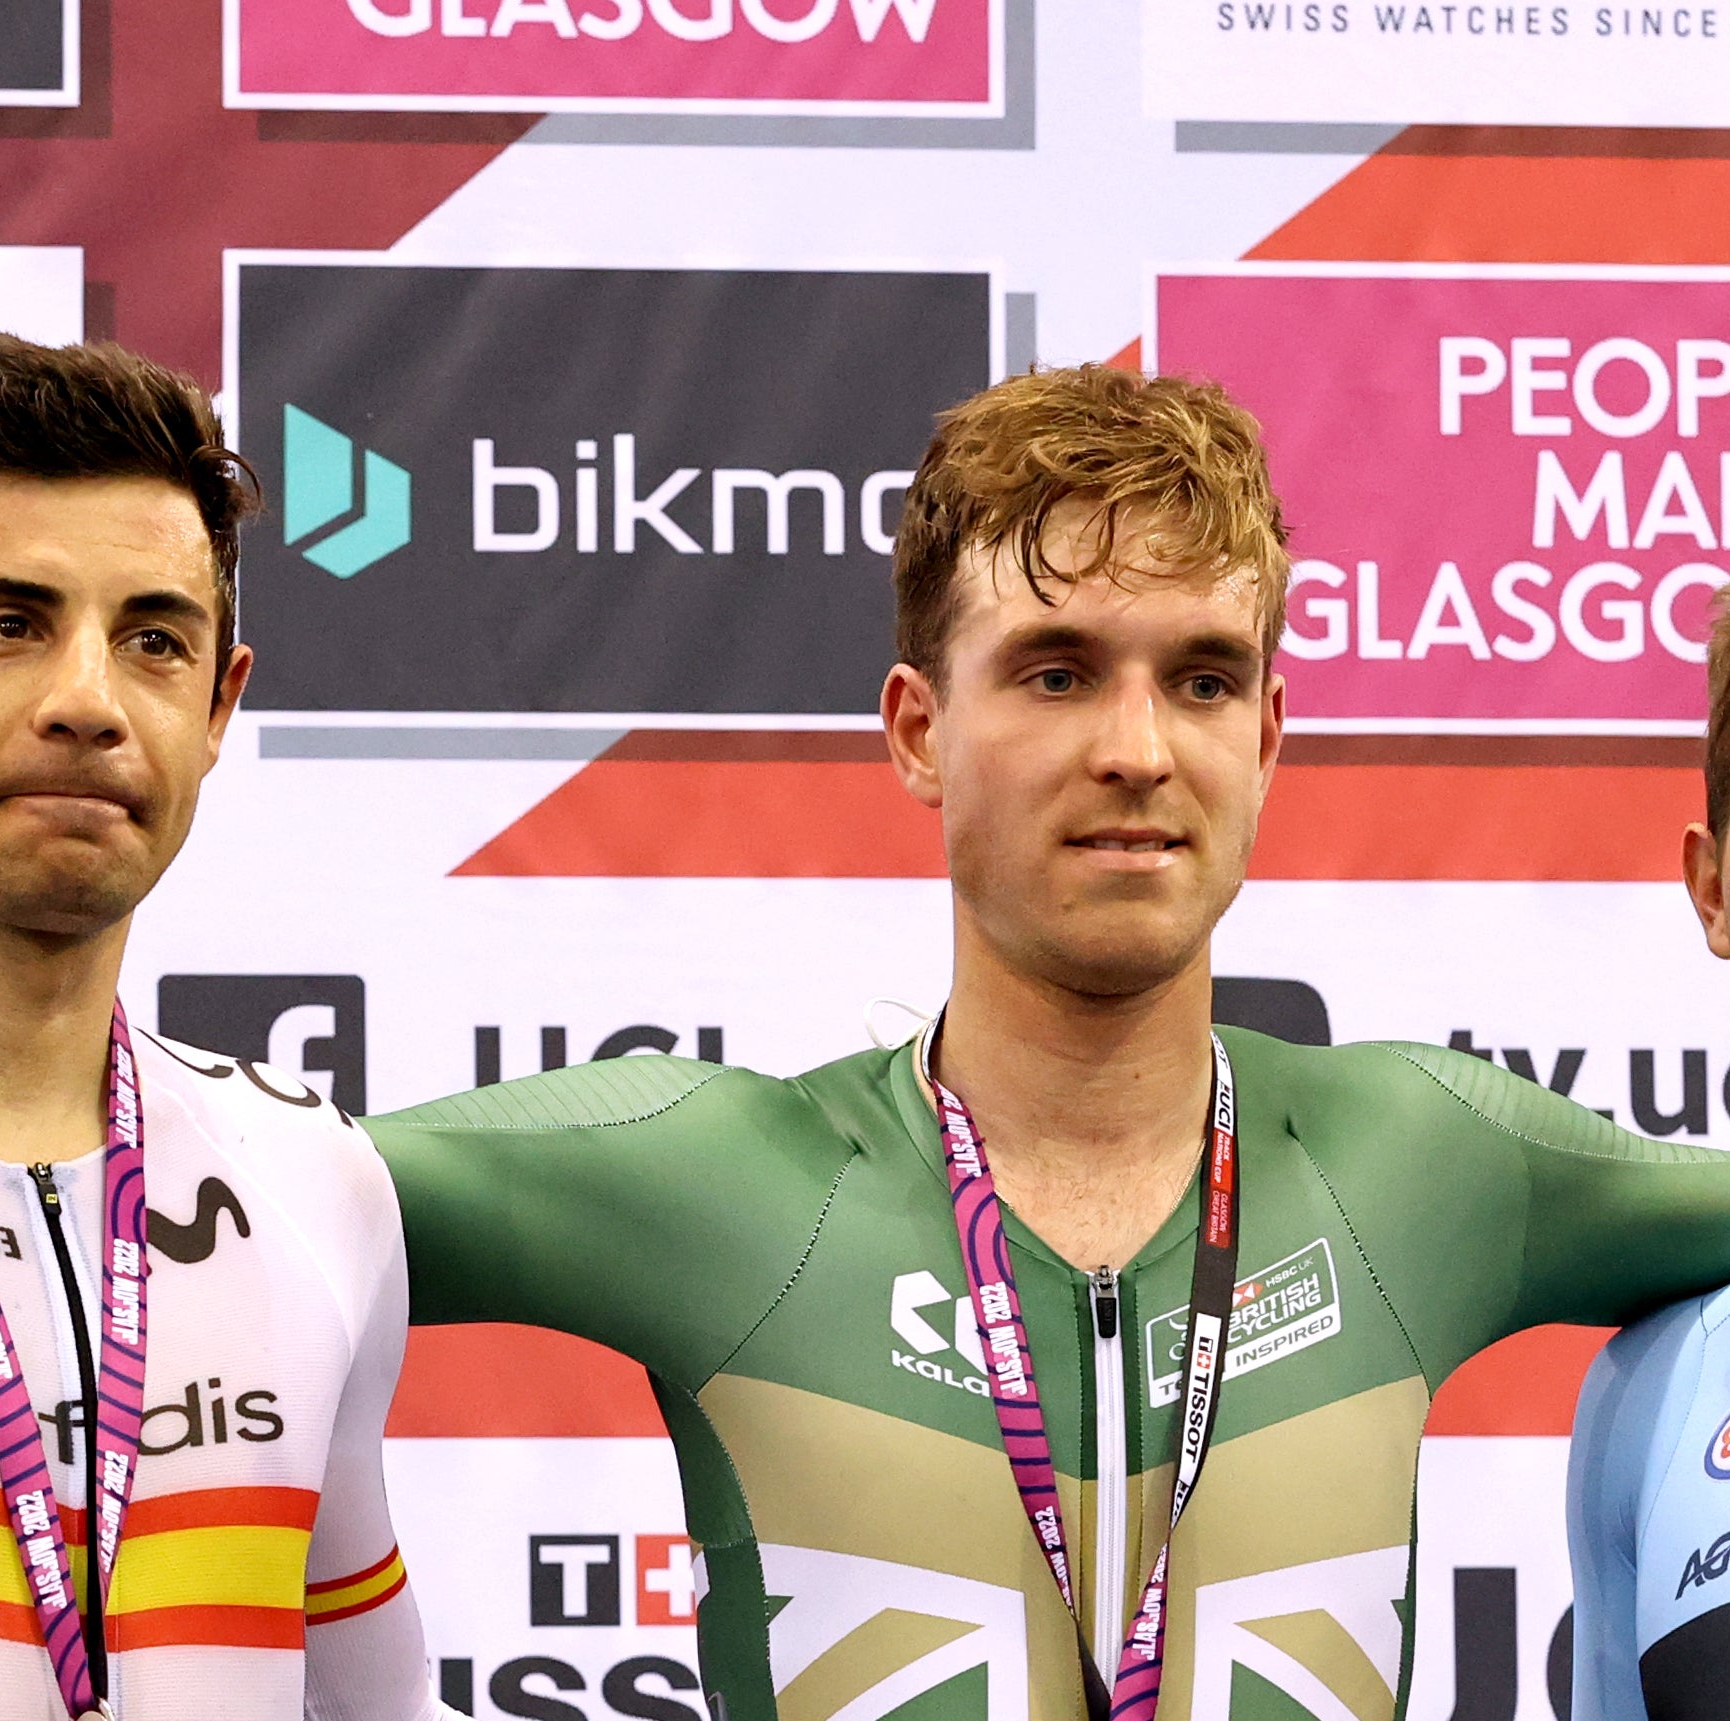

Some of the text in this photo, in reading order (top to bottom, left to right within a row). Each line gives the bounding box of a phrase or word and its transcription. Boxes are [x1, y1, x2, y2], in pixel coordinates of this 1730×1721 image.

[1217, 1, 1350, 34] SWISS
[1373, 3, 1569, 38] WATCHES
[1594, 7, 1718, 39] SINCE
[1265, 1265, 1298, 1289] HSBC
[1228, 1292, 1322, 1344] CYCLING
[1235, 1314, 1334, 1367] INSPIRED
[1185, 1372, 1211, 1463] TISSOT
